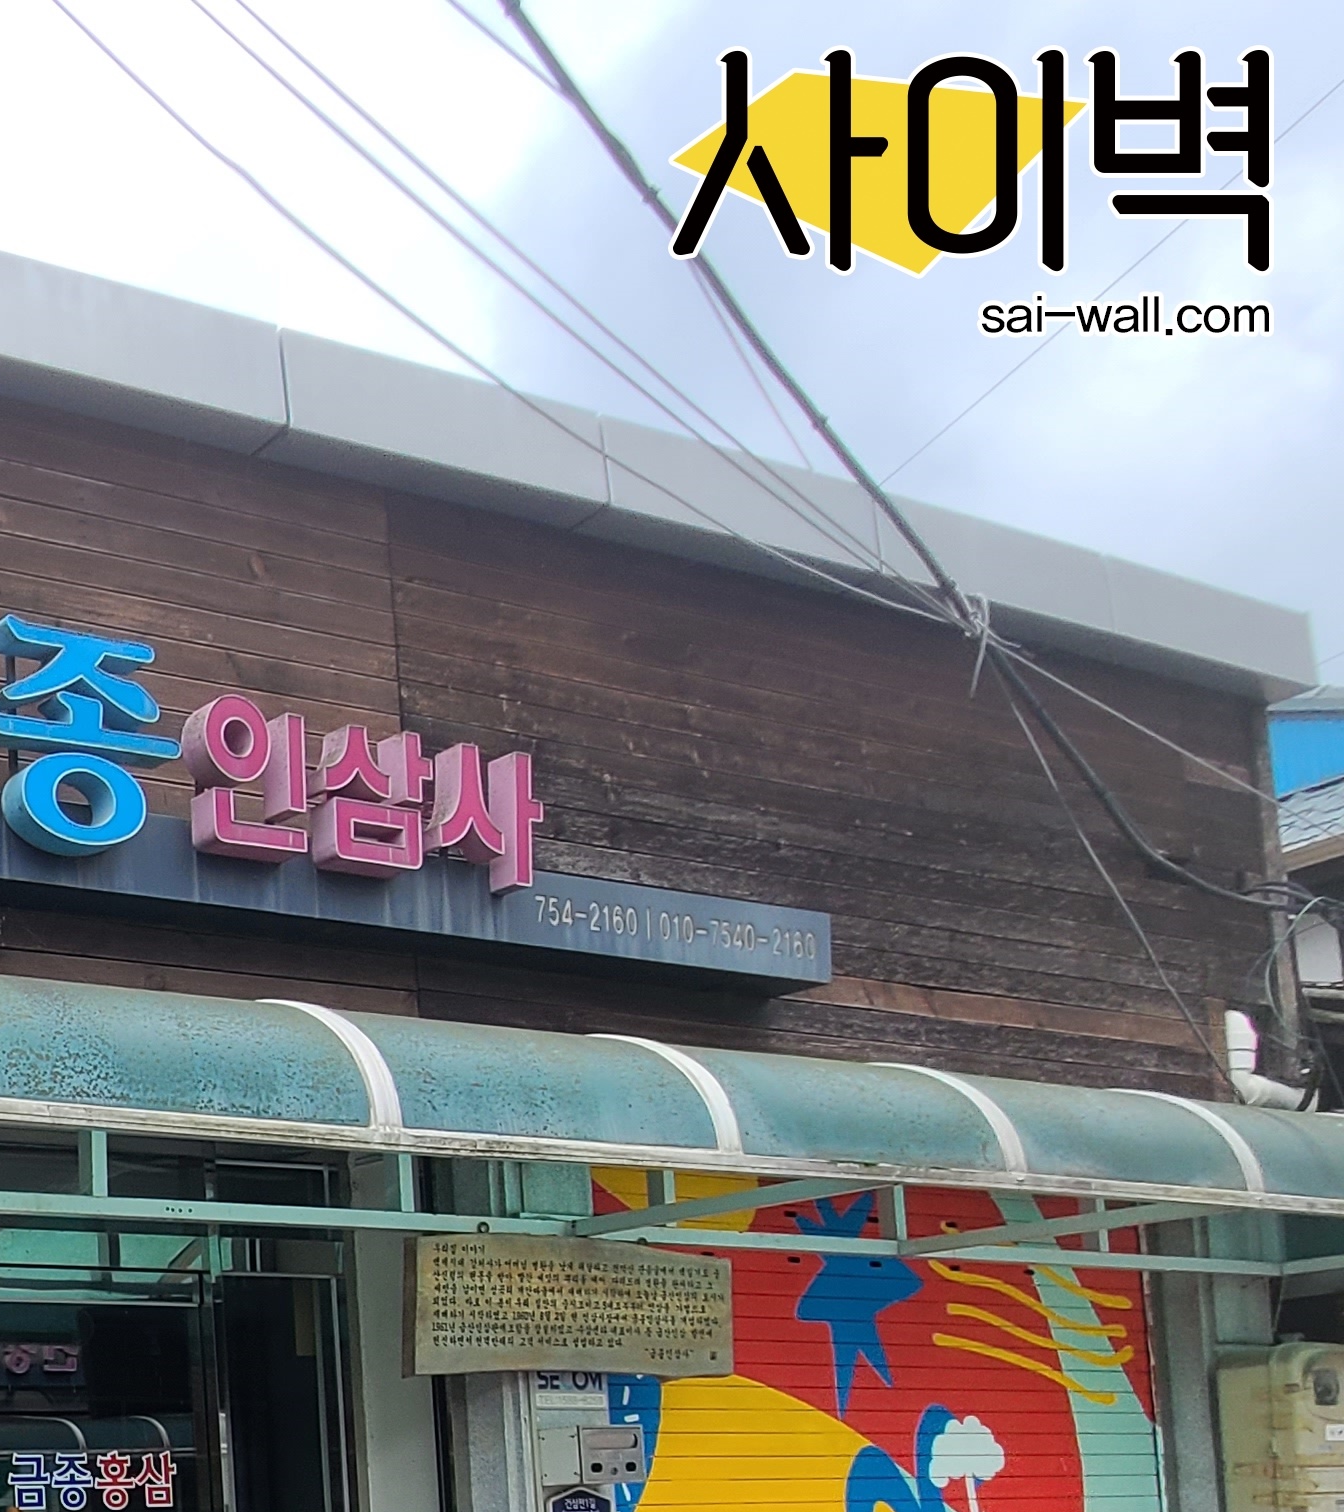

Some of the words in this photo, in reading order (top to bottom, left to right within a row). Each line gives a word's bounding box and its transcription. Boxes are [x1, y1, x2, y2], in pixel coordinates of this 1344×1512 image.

[181, 694, 543, 895] 인삼사
[535, 895, 637, 936] 754-2160
[659, 912, 816, 960] 010-7540-2160
[7, 1450, 177, 1511] 금종홍삼
